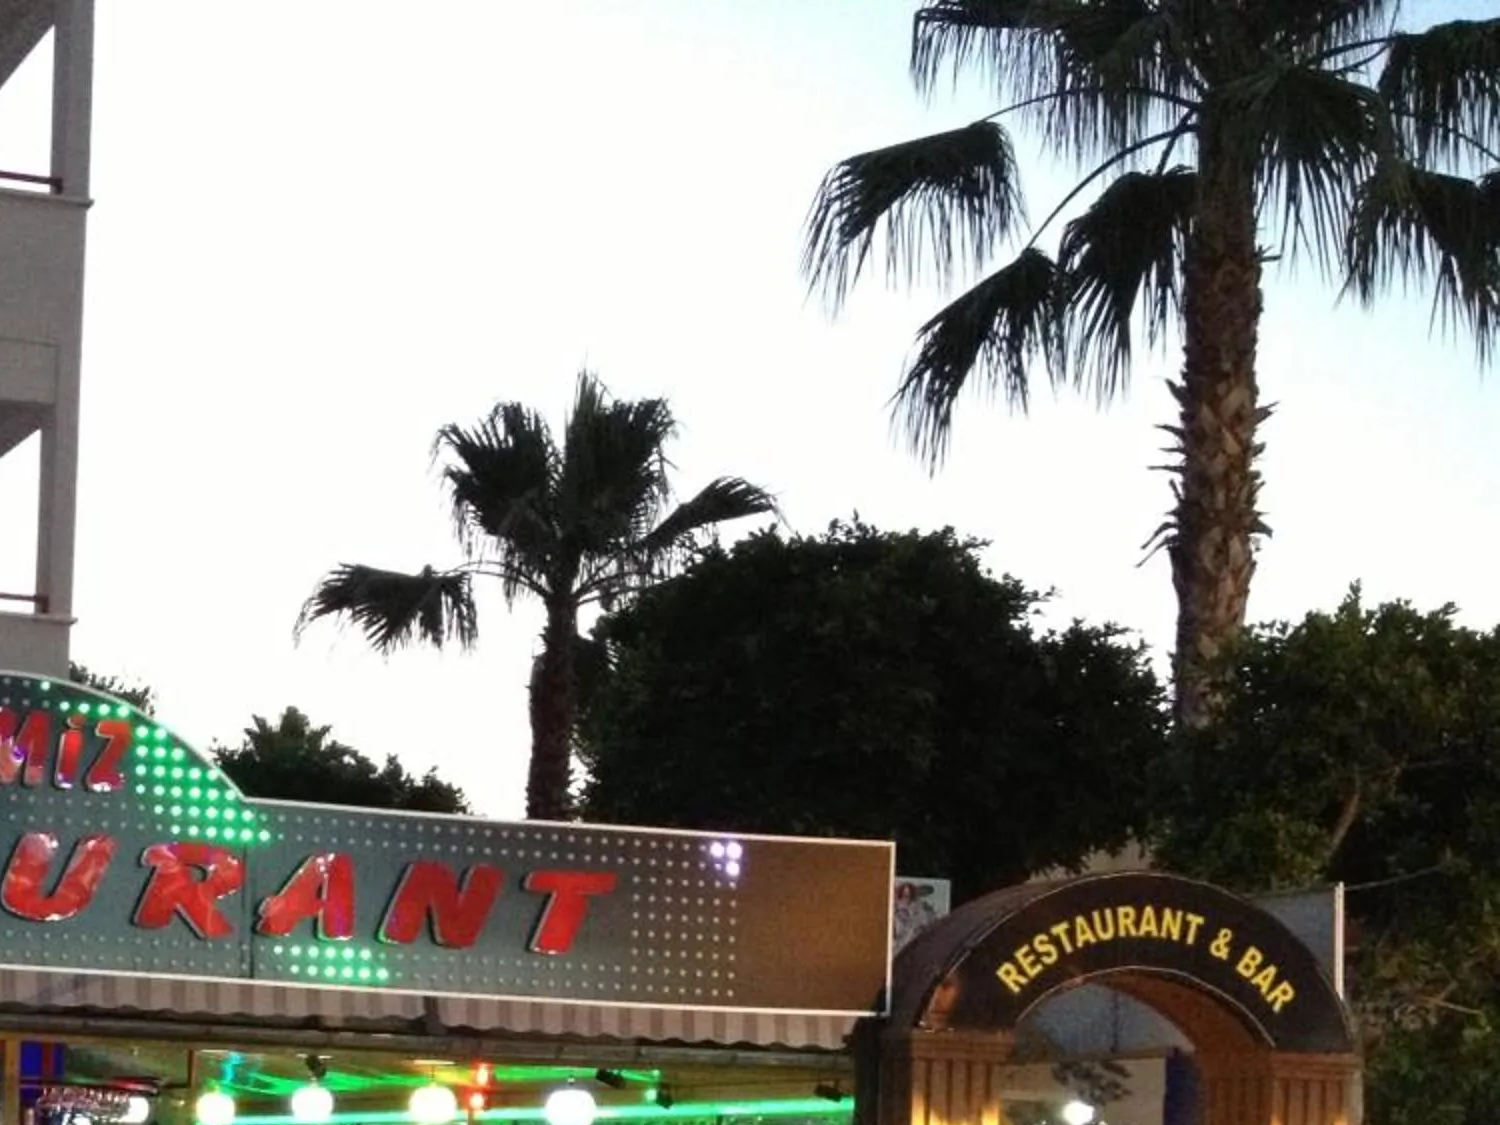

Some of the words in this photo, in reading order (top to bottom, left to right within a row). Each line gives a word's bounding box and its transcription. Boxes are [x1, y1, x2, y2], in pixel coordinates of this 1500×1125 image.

[997, 905, 1205, 994] RESTAURANT
[1209, 928, 1234, 960] &
[1236, 946, 1295, 1012] BAR
